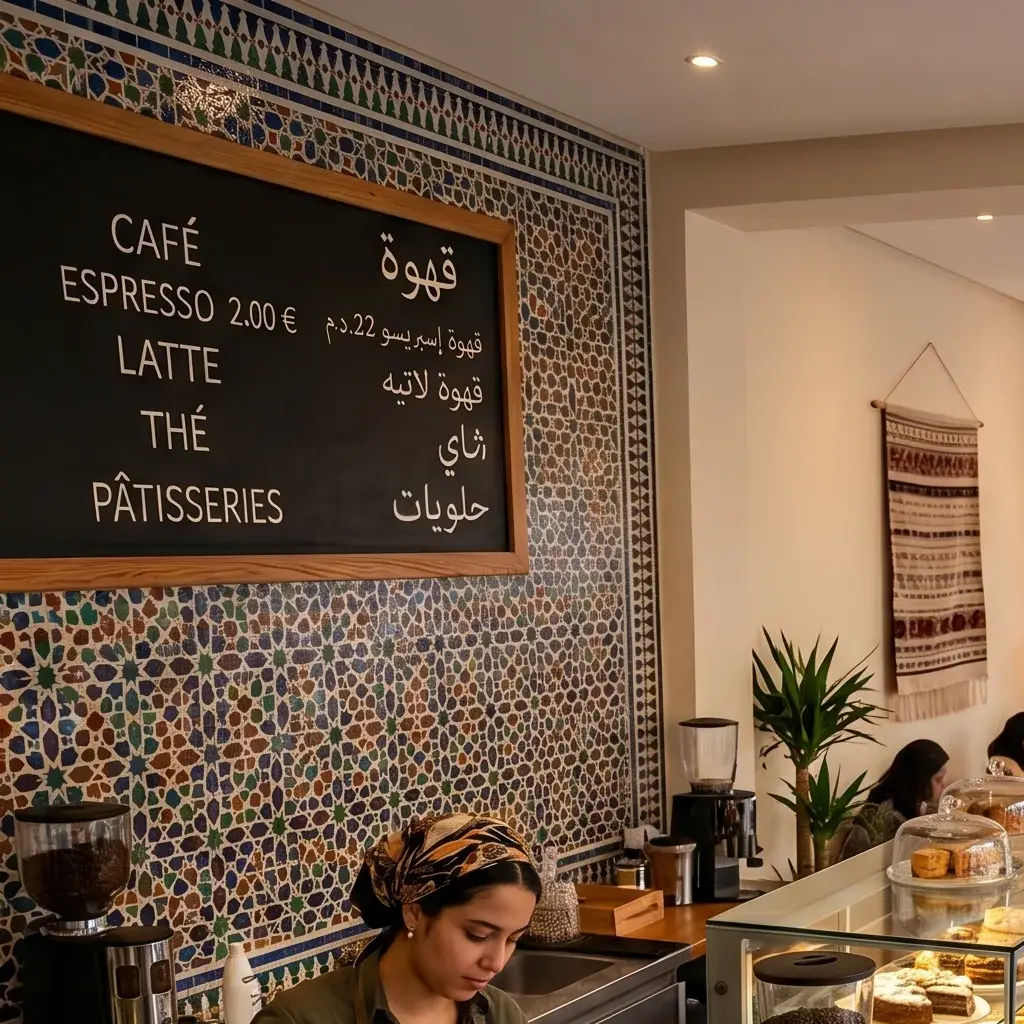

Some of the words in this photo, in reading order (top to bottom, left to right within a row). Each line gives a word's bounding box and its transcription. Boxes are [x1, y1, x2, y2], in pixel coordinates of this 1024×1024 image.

[111, 213, 202, 267] CAFÉ
[380, 232, 458, 303] قهوة
[60, 264, 214, 323] ESPRESSO
[117, 334, 222, 384] LATTE
[448, 328, 483, 359] قهوة
[382, 368, 429, 406] لاتيه
[438, 372, 483, 412] قهوة
[140, 404, 210, 452] THÉ
[92, 470, 284, 523] PÂTISSERIES
[392, 483, 490, 534] حلويات
